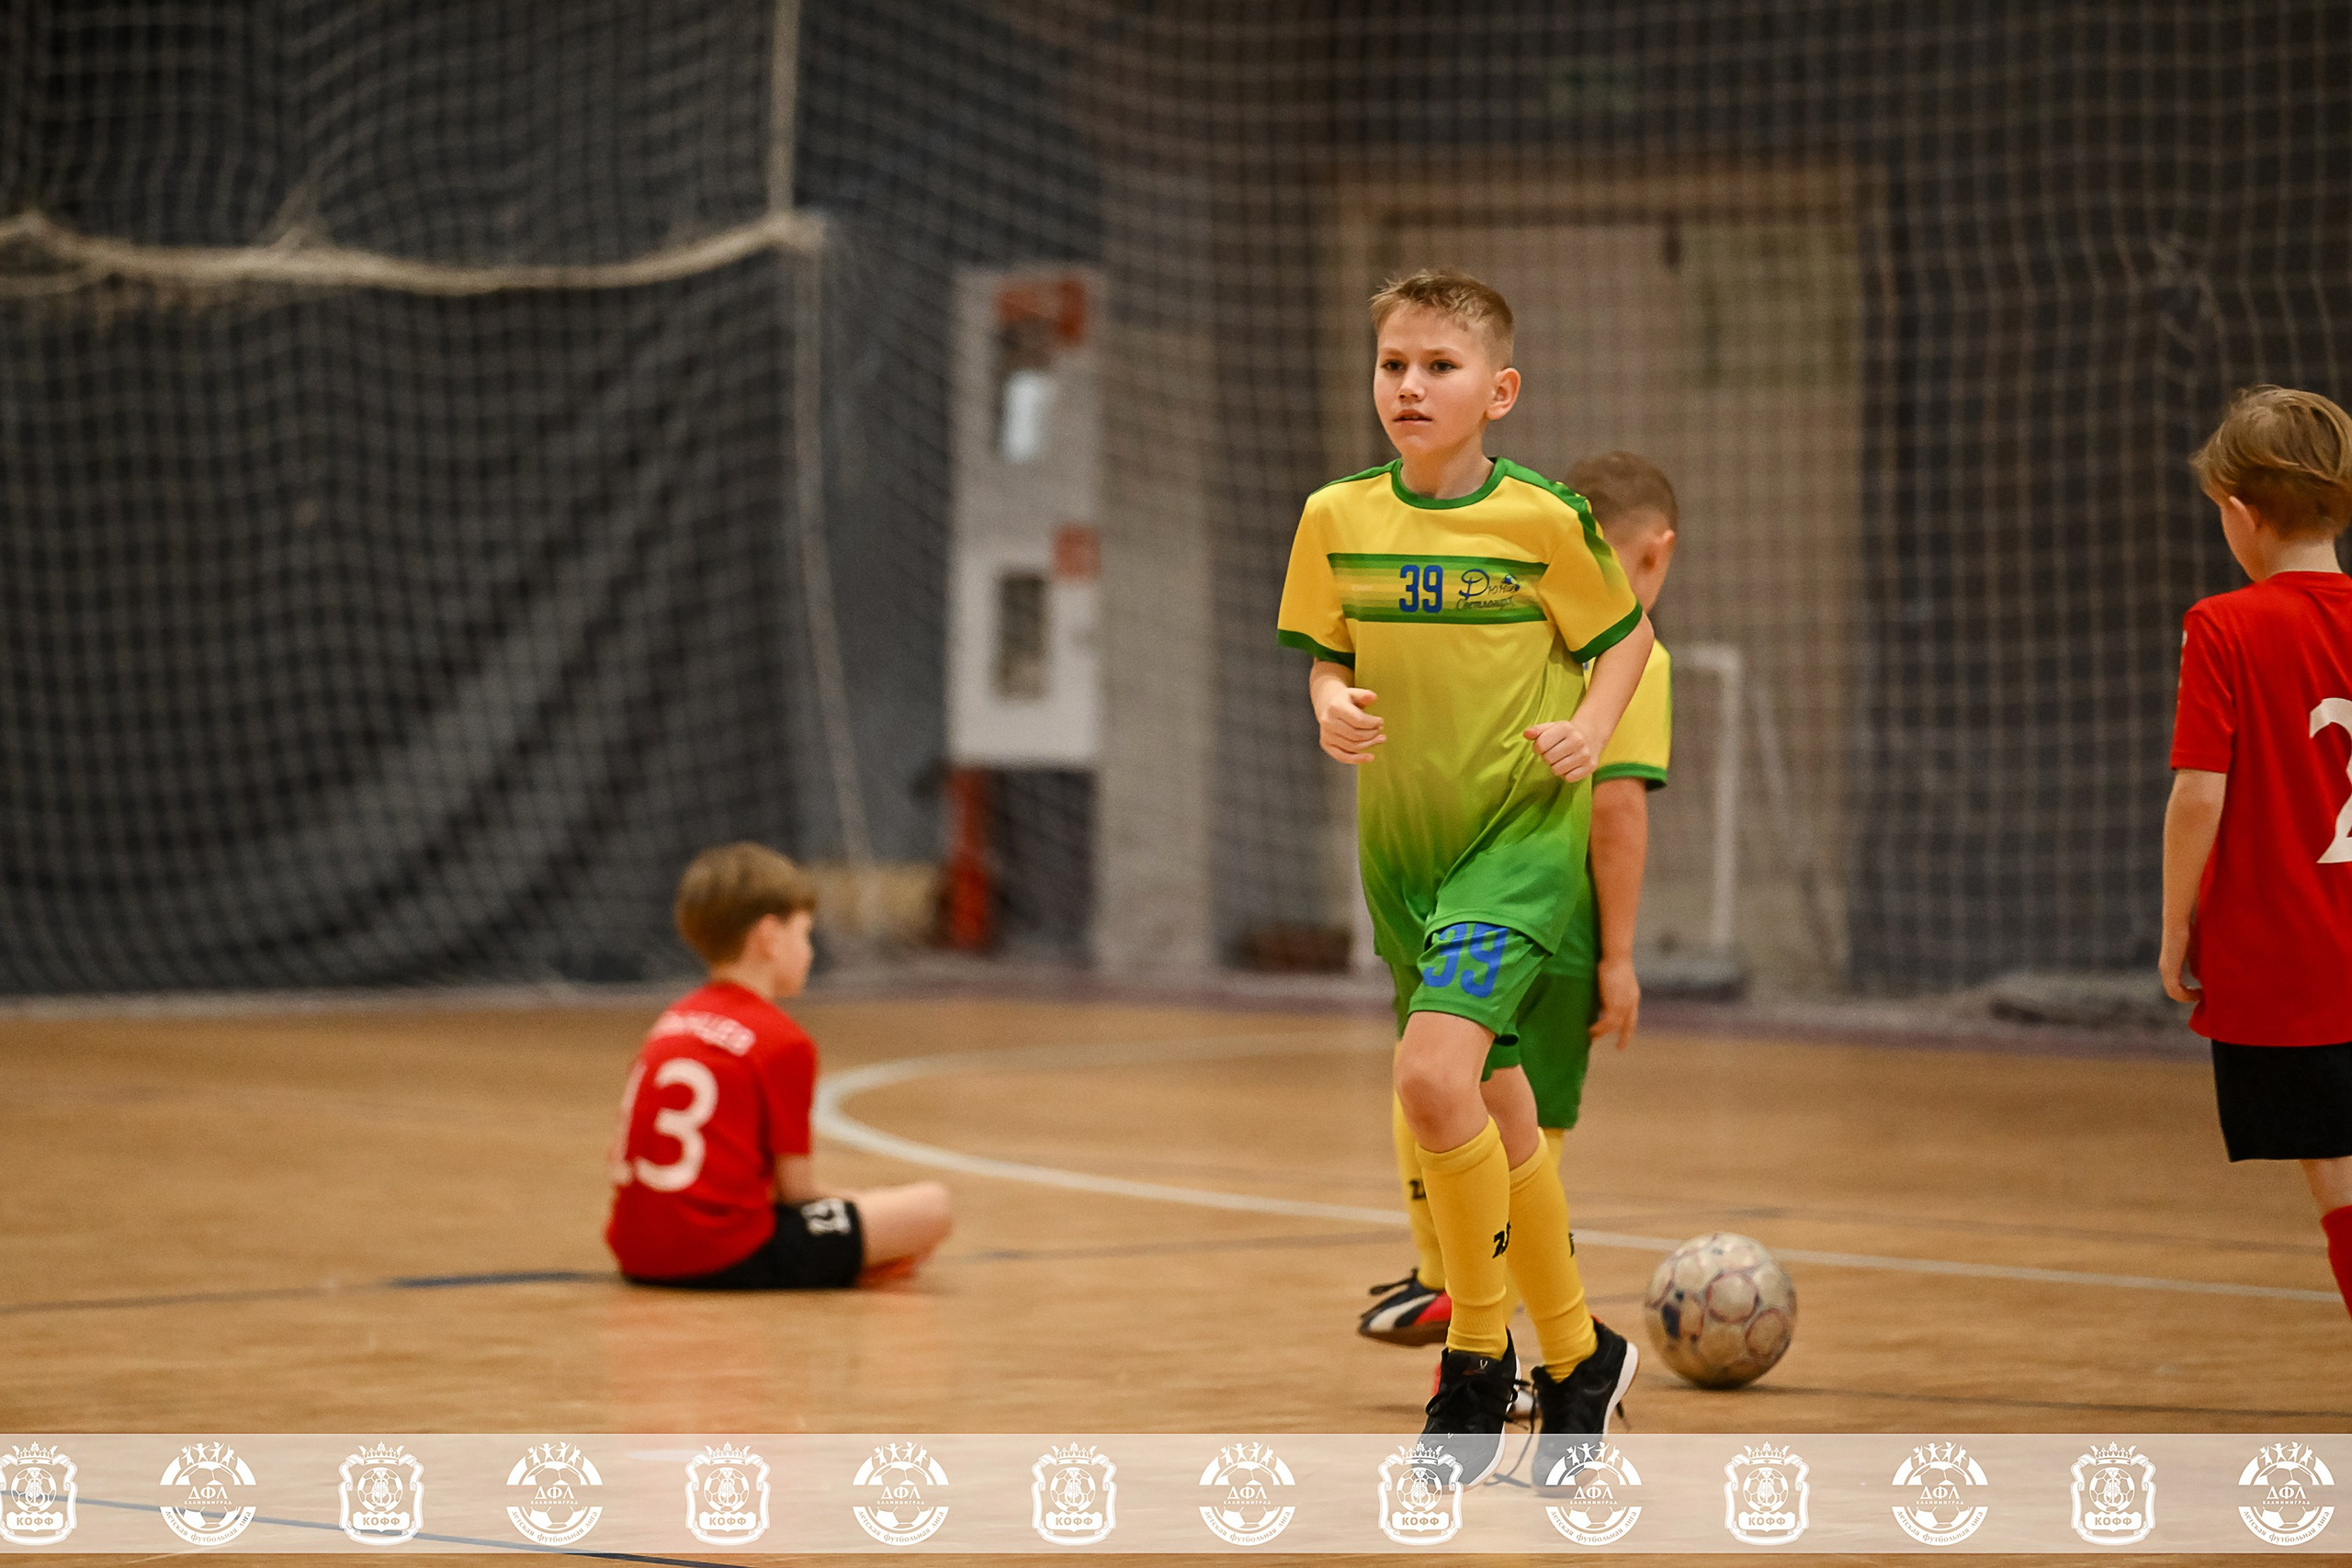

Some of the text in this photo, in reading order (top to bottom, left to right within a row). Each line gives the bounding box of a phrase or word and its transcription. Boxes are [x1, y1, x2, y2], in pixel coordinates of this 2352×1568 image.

[1399, 564, 1443, 614] 39
[1423, 922, 1510, 998] 39
[608, 1056, 719, 1193] 13
